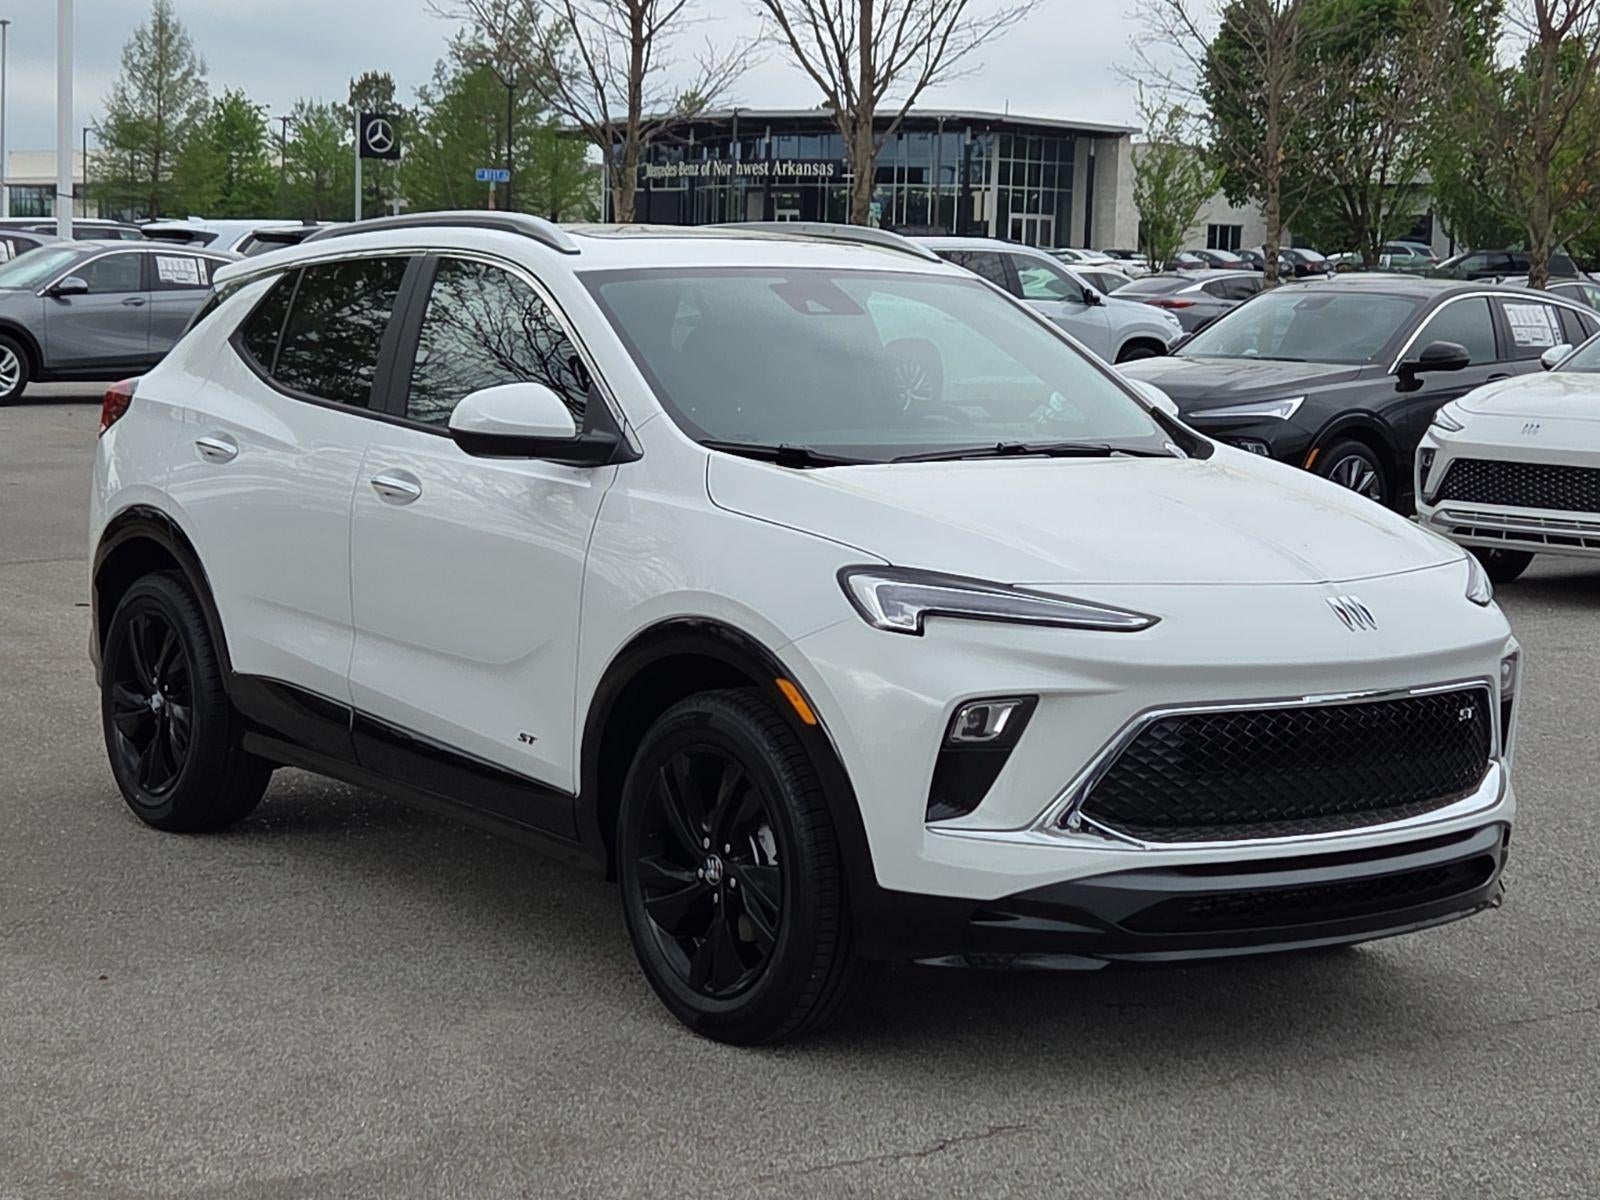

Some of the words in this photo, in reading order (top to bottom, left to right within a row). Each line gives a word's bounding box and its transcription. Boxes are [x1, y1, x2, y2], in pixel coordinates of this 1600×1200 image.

[701, 160, 711, 176] of
[713, 160, 769, 177] Norhwest
[772, 160, 834, 176] Arkansas
[517, 732, 538, 745] ST
